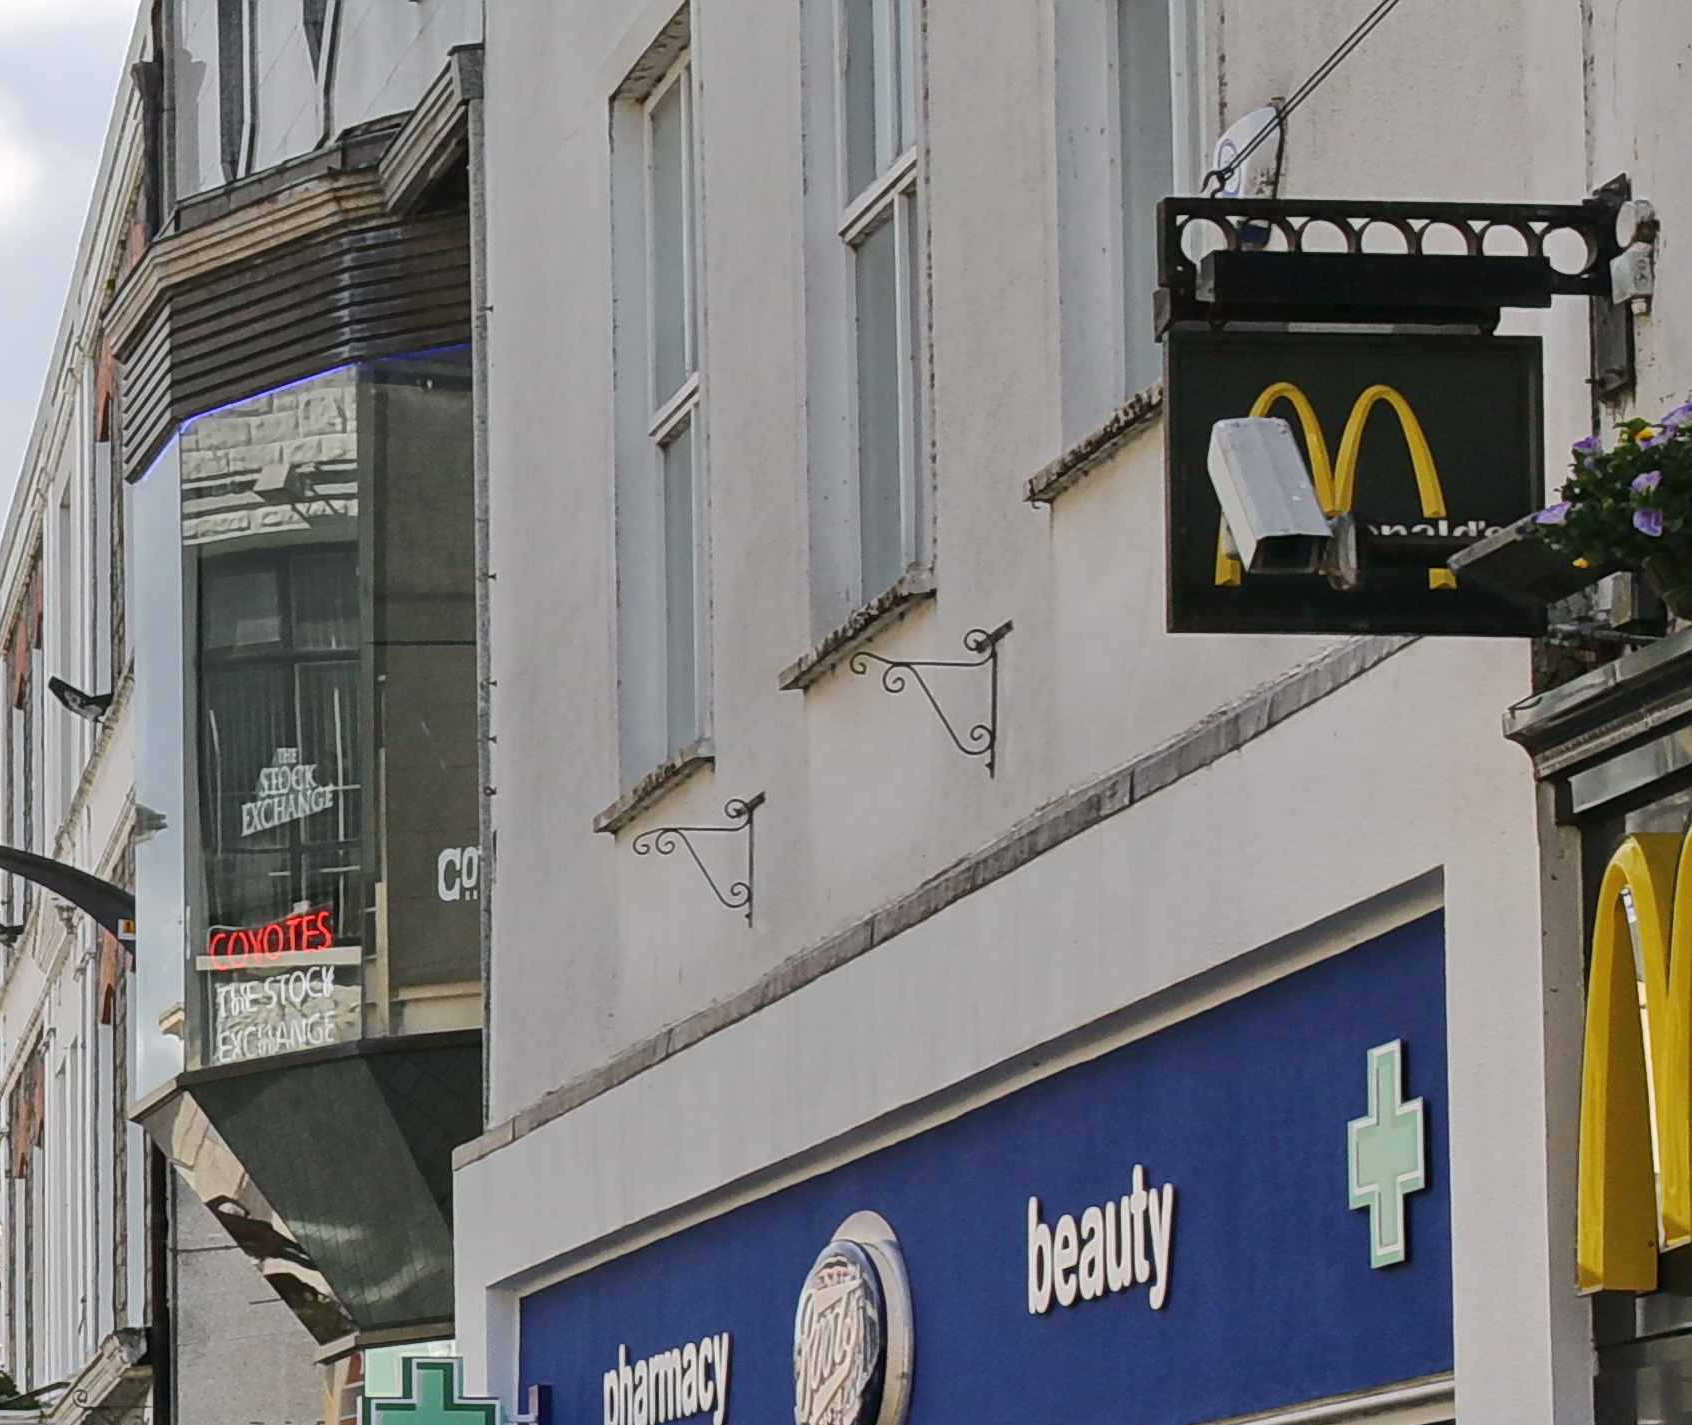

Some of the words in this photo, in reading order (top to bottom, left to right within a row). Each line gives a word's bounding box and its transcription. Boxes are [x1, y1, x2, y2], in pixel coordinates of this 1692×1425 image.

[259, 763, 318, 797] STOCK
[277, 747, 298, 764] THE
[241, 784, 334, 836] EXCHANGE
[209, 910, 334, 971] COYOTES
[216, 979, 261, 1018] THE
[264, 964, 335, 1009] STOCK
[217, 1010, 336, 1063] EXCHANGE
[1027, 1164, 1174, 1314] beauty
